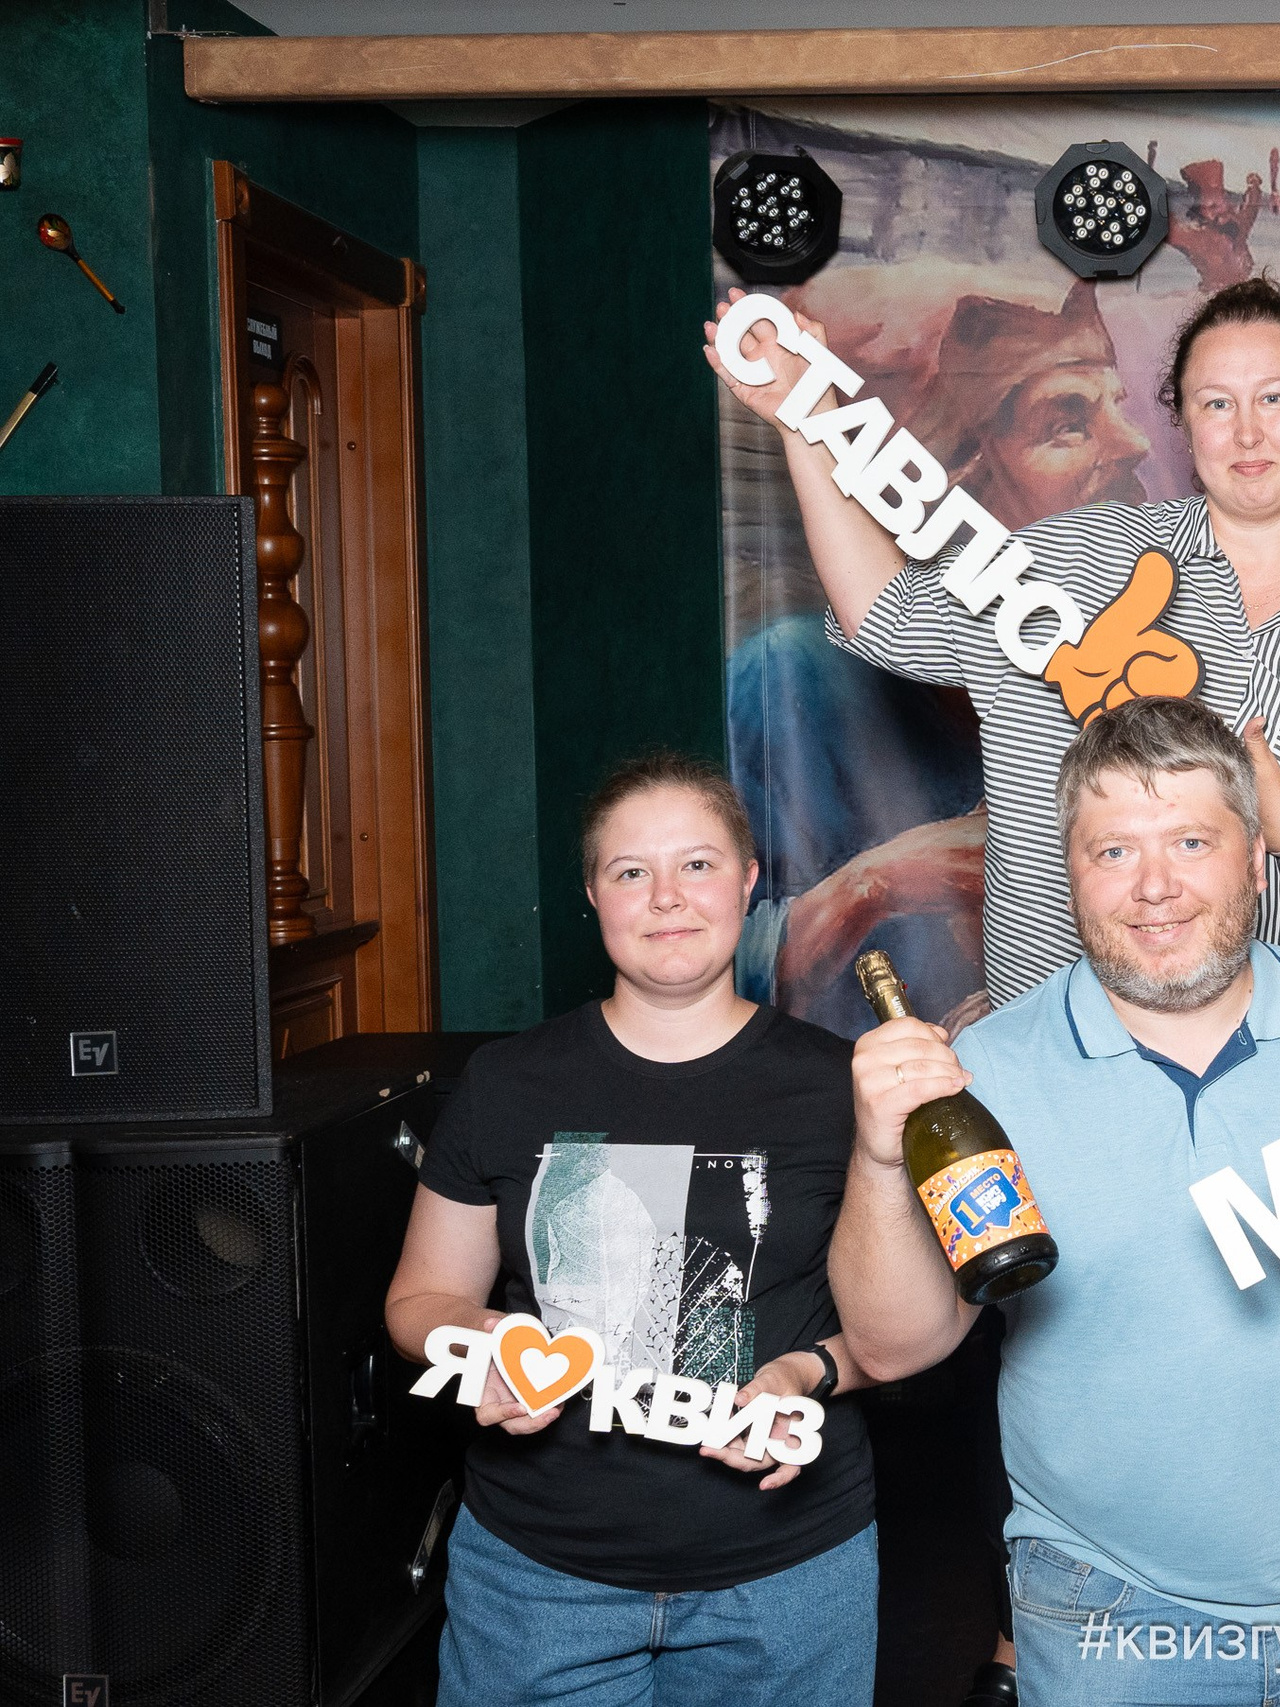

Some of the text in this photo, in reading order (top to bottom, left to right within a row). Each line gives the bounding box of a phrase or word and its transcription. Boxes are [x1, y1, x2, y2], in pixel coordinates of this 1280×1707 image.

[715, 293, 1086, 676] СТАВЛЮ
[78, 1039, 110, 1066] EV
[956, 1173, 1002, 1229] 1 МЕСТО
[408, 1325, 826, 1466] Я КВИЗ
